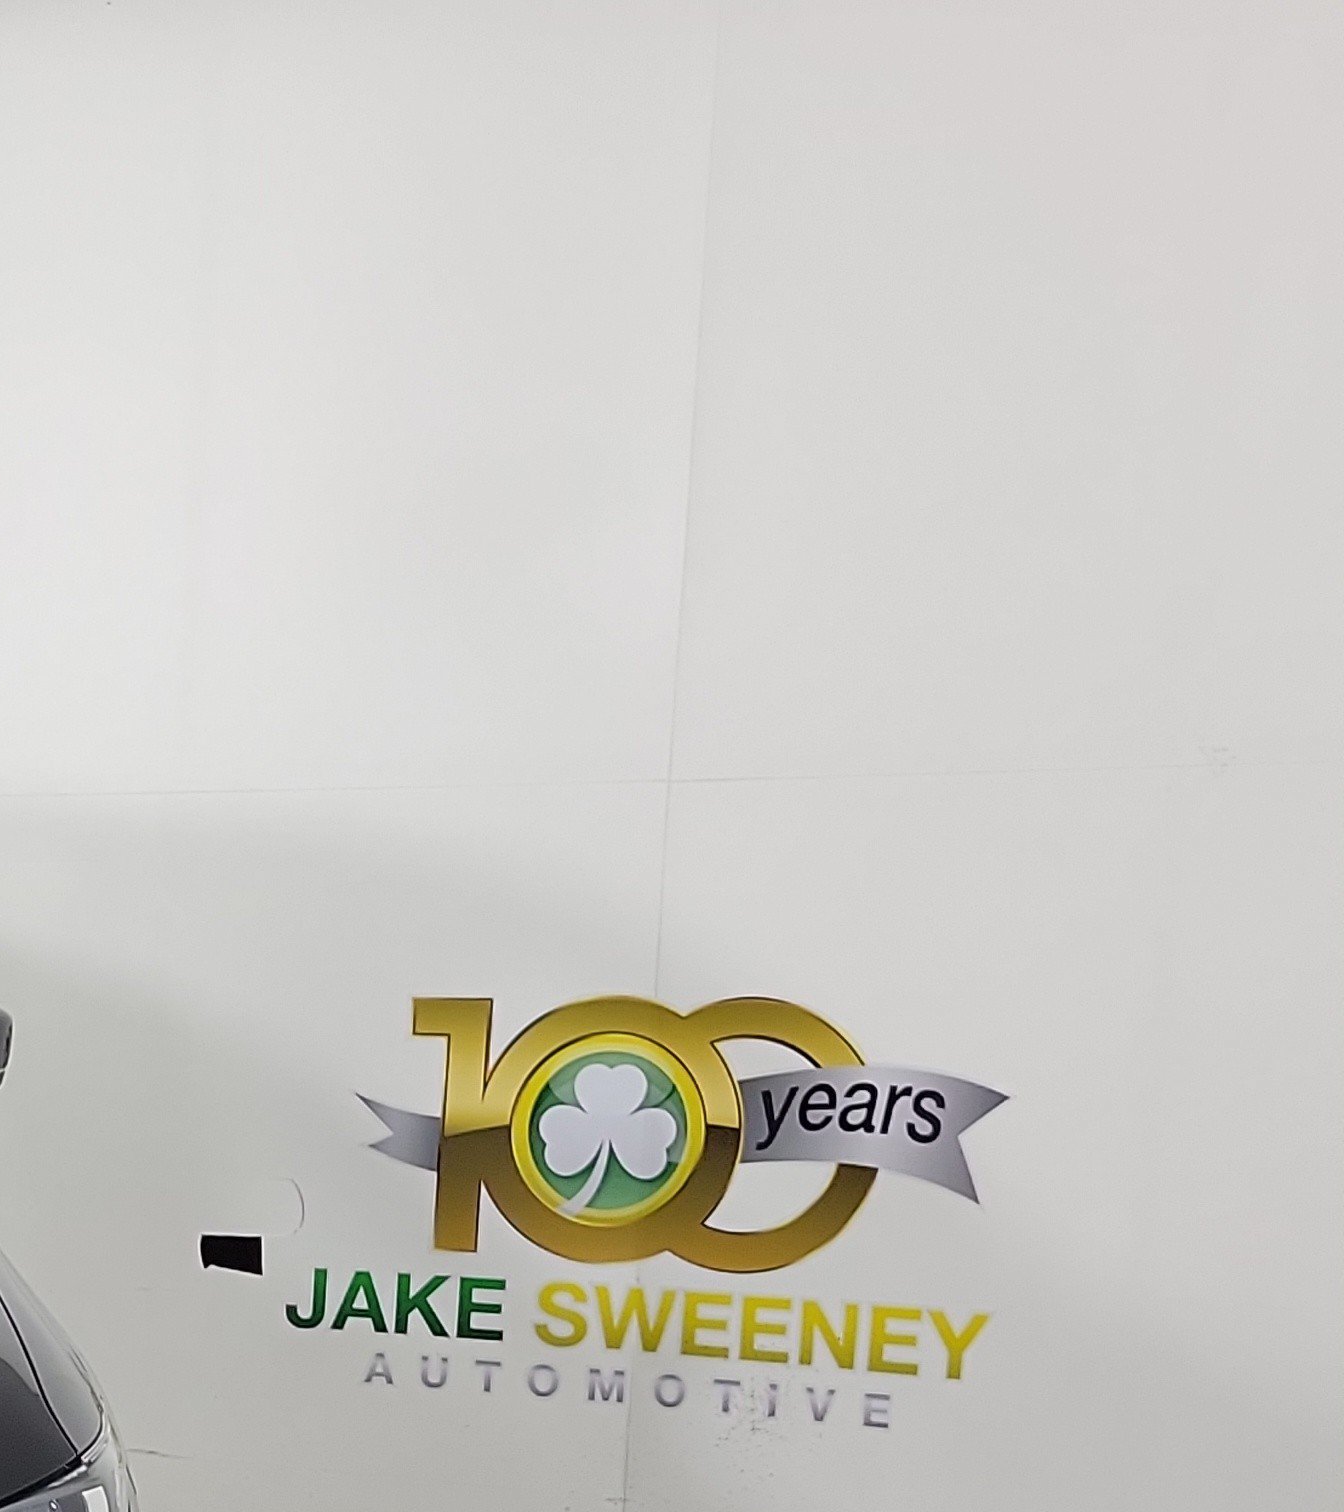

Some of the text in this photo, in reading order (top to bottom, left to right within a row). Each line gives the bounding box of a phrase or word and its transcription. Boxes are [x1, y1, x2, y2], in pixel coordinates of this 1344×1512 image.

[412, 996, 946, 1274] 100 years
[285, 1266, 990, 1381] JAKE SWEENEY
[364, 1352, 891, 1429] AUTOMOTIVE
